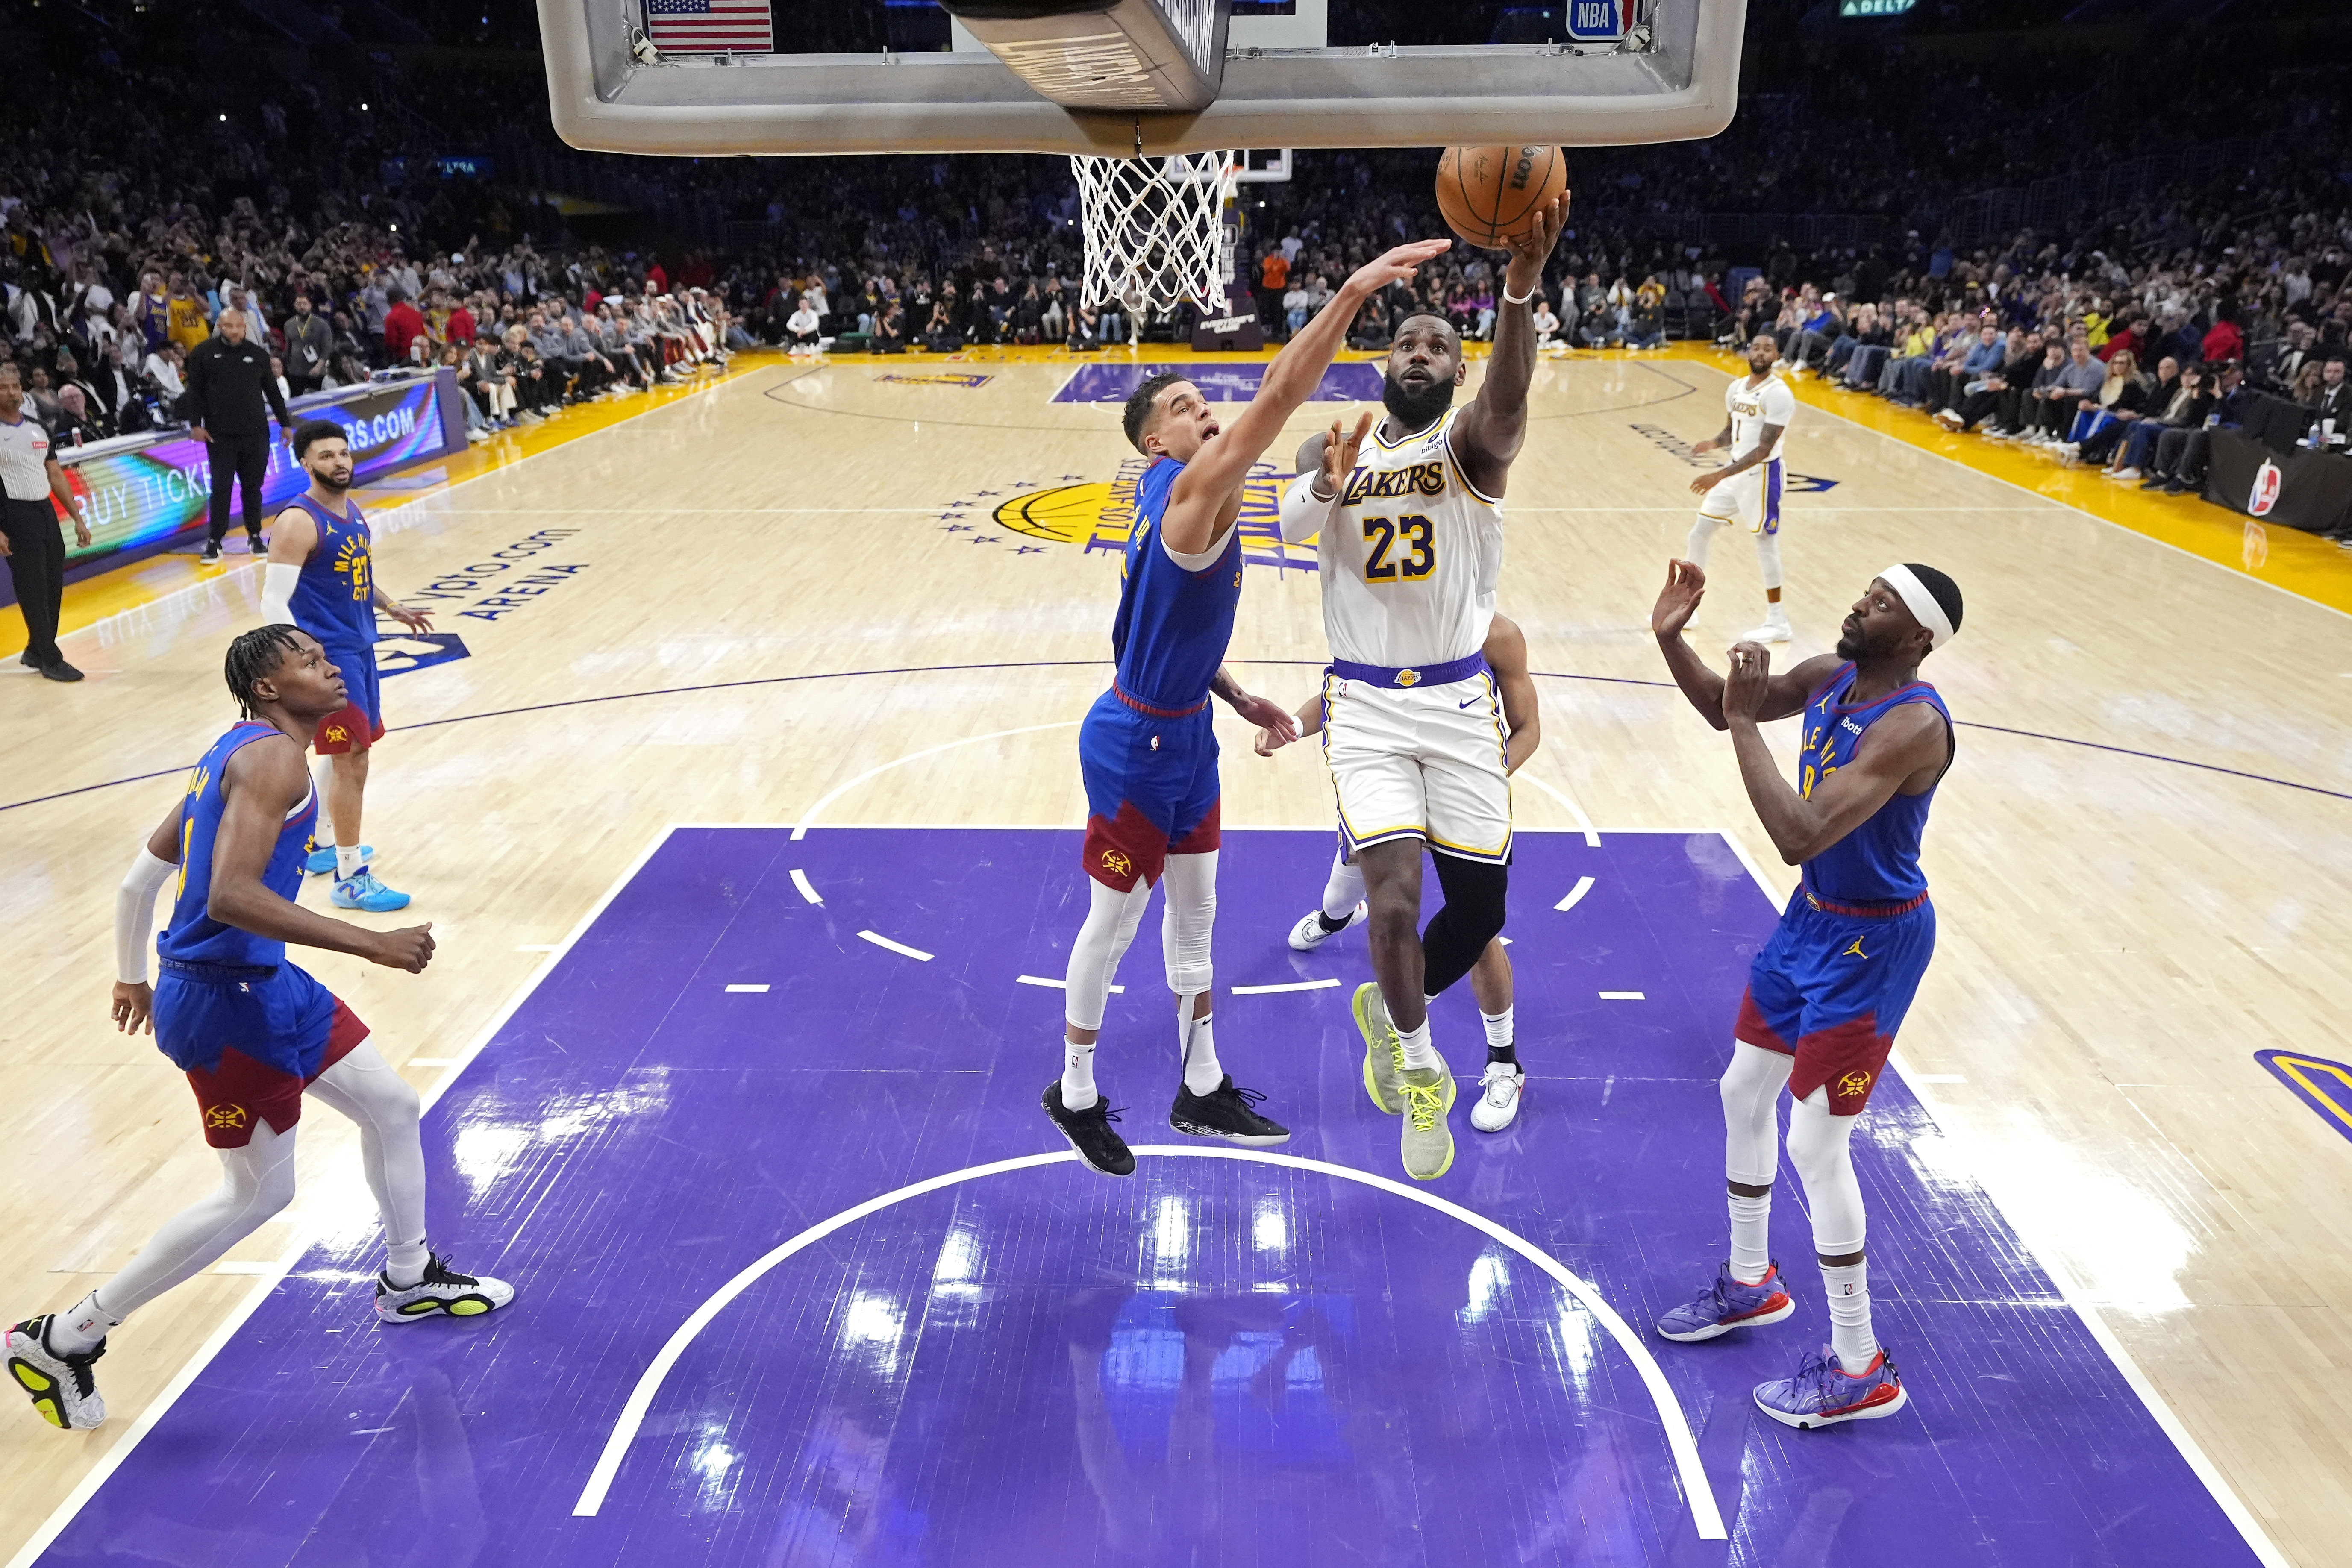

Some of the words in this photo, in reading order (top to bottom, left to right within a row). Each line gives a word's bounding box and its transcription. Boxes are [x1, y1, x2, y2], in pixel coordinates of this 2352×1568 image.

[1577, 3, 1609, 28] NBA
[1421, 439, 1443, 454] bibigo
[74, 483, 127, 529] BUY
[138, 461, 212, 510] TICKE
[1341, 462, 1447, 508] LAKERS
[1096, 506, 1135, 530] LOS
[334, 535, 357, 572] MILE
[1362, 514, 1437, 584] 23
[352, 555, 369, 586] 27
[353, 585, 370, 602] CIT
[455, 563, 590, 621] ARENA
